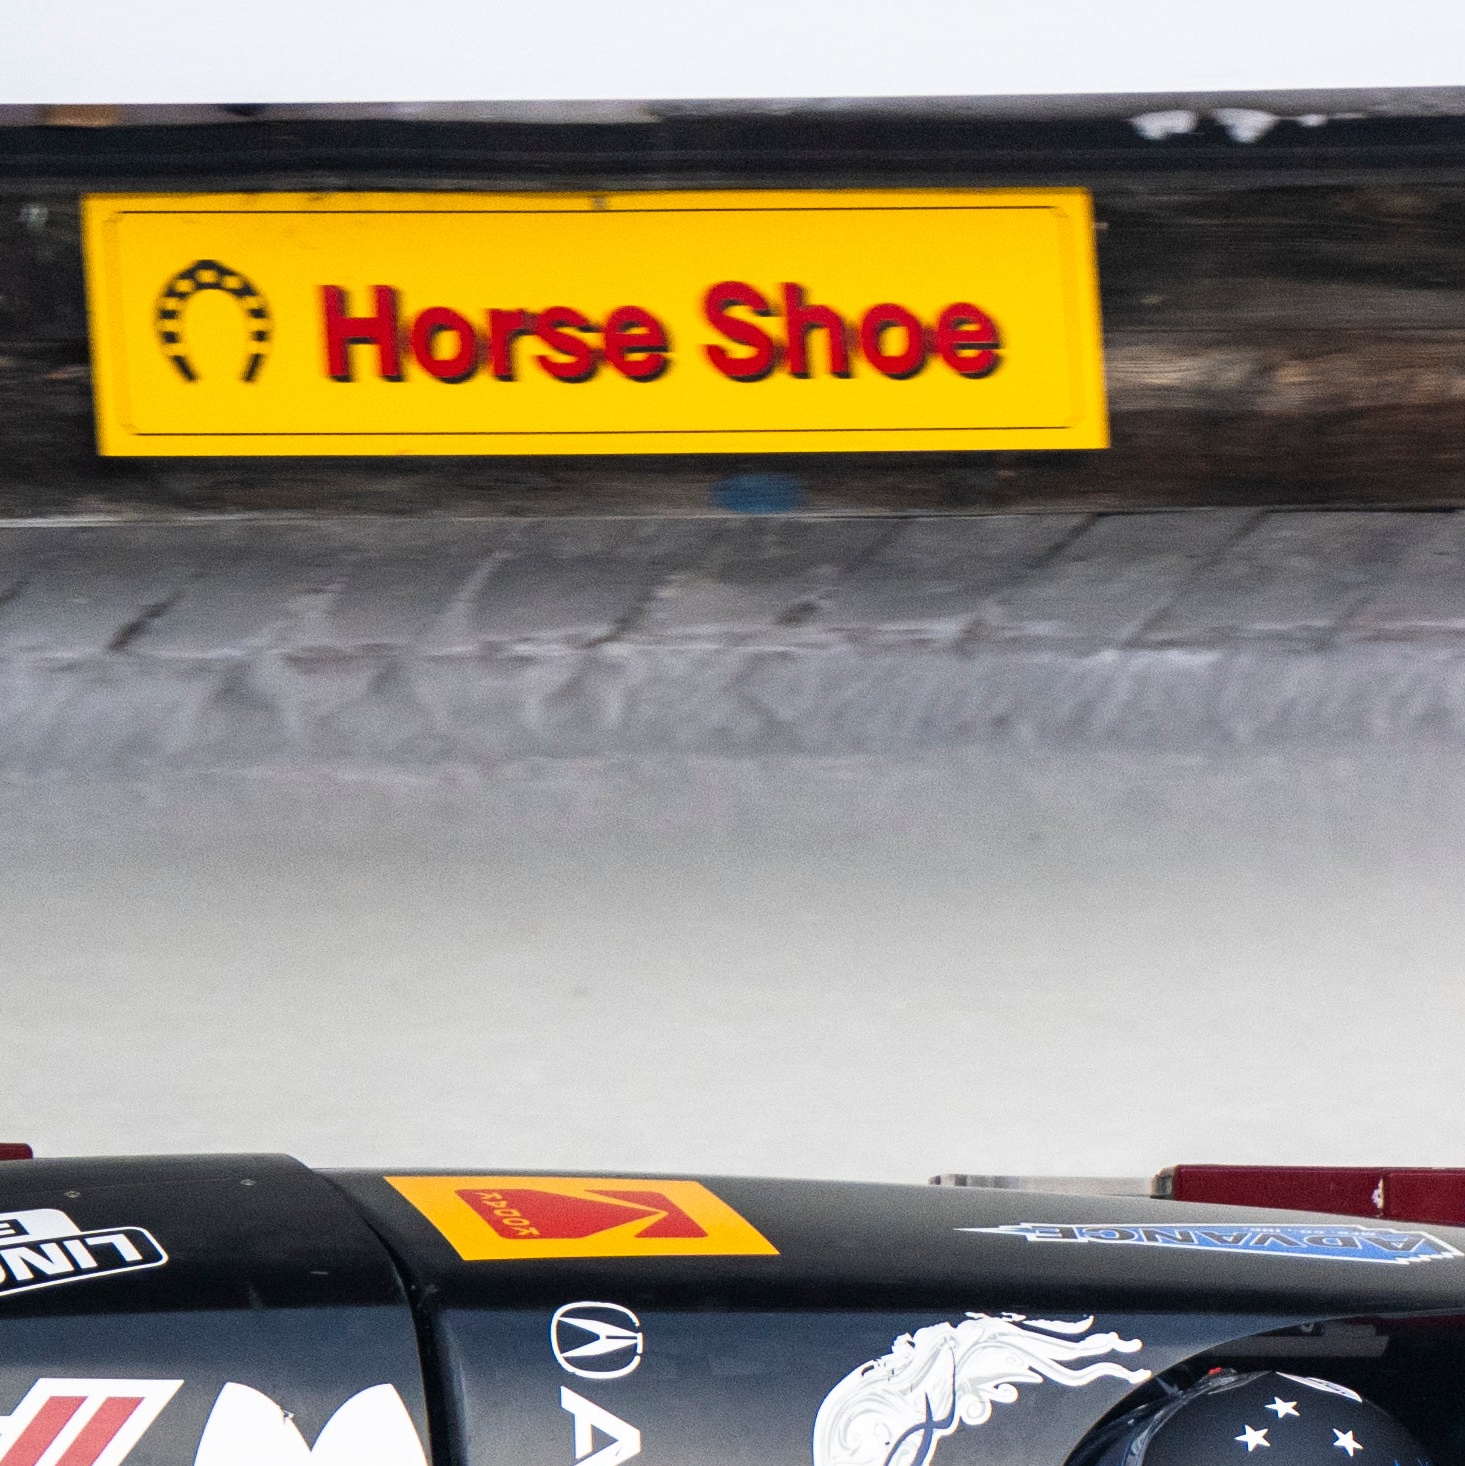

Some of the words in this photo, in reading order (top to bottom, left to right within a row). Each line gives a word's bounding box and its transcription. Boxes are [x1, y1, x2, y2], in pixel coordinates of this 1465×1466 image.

[318, 283, 672, 384] Horse
[703, 280, 1004, 384] Shoe
[477, 1190, 540, 1237] KODAK
[1033, 1226, 1425, 1253] ADVANCE
